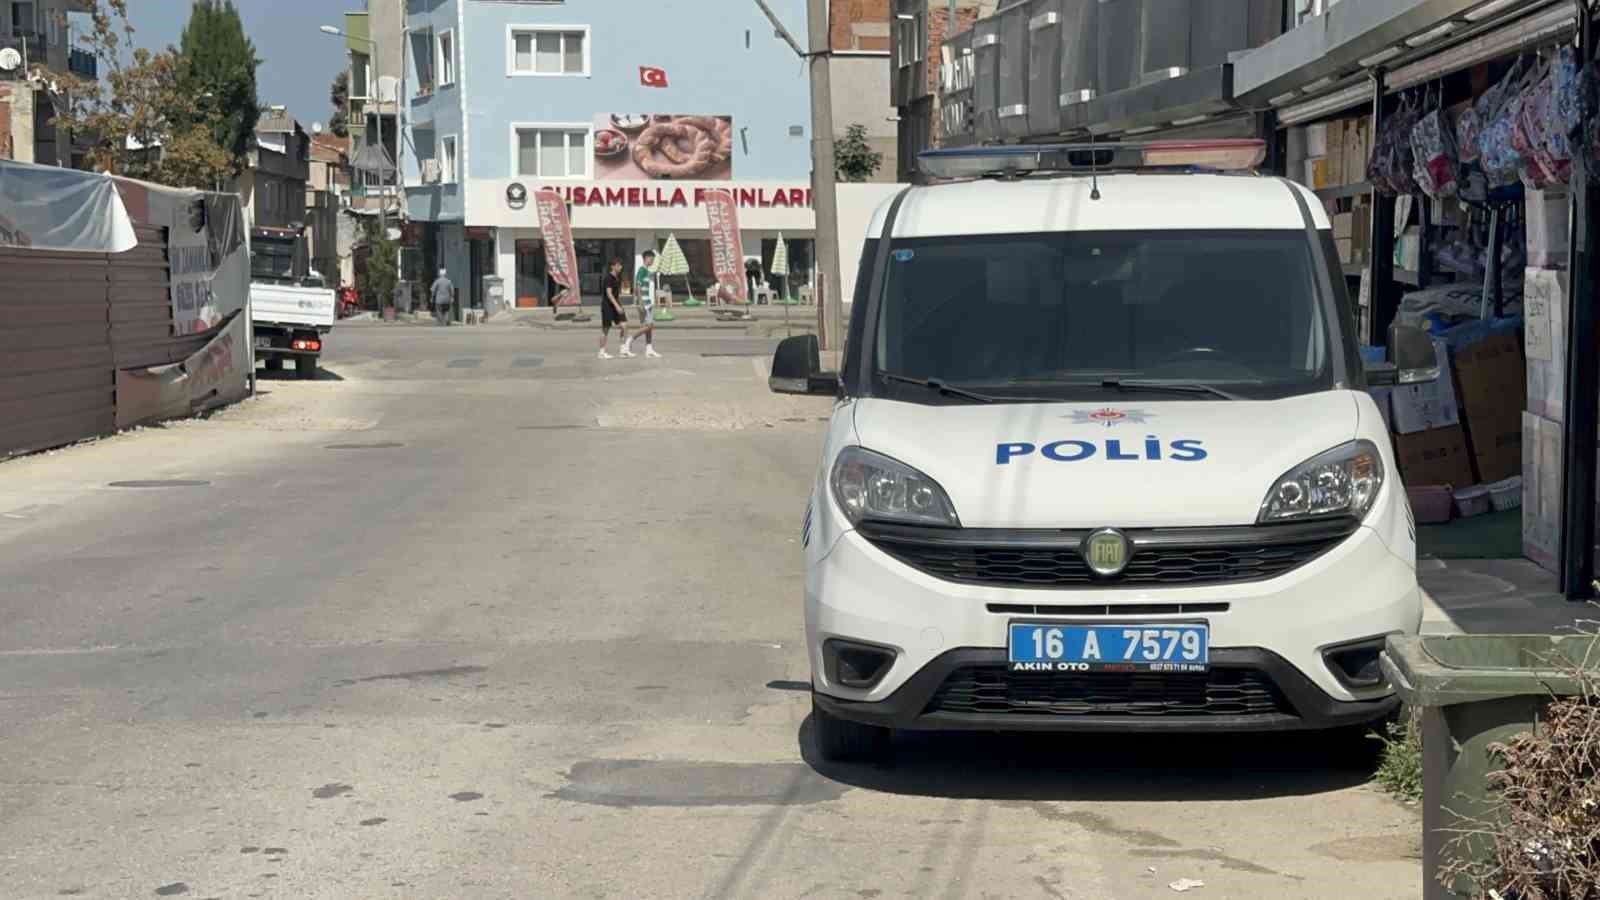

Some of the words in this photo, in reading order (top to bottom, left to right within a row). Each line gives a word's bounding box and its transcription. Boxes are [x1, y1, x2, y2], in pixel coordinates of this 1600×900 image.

[996, 435, 1208, 464] POLİS
[1094, 543, 1122, 563] FIAT
[1032, 628, 1064, 658] 16
[1081, 630, 1101, 659] A
[1123, 630, 1200, 660] 7579
[1013, 662, 1053, 671] AKIN
[1057, 662, 1090, 671] OTO
